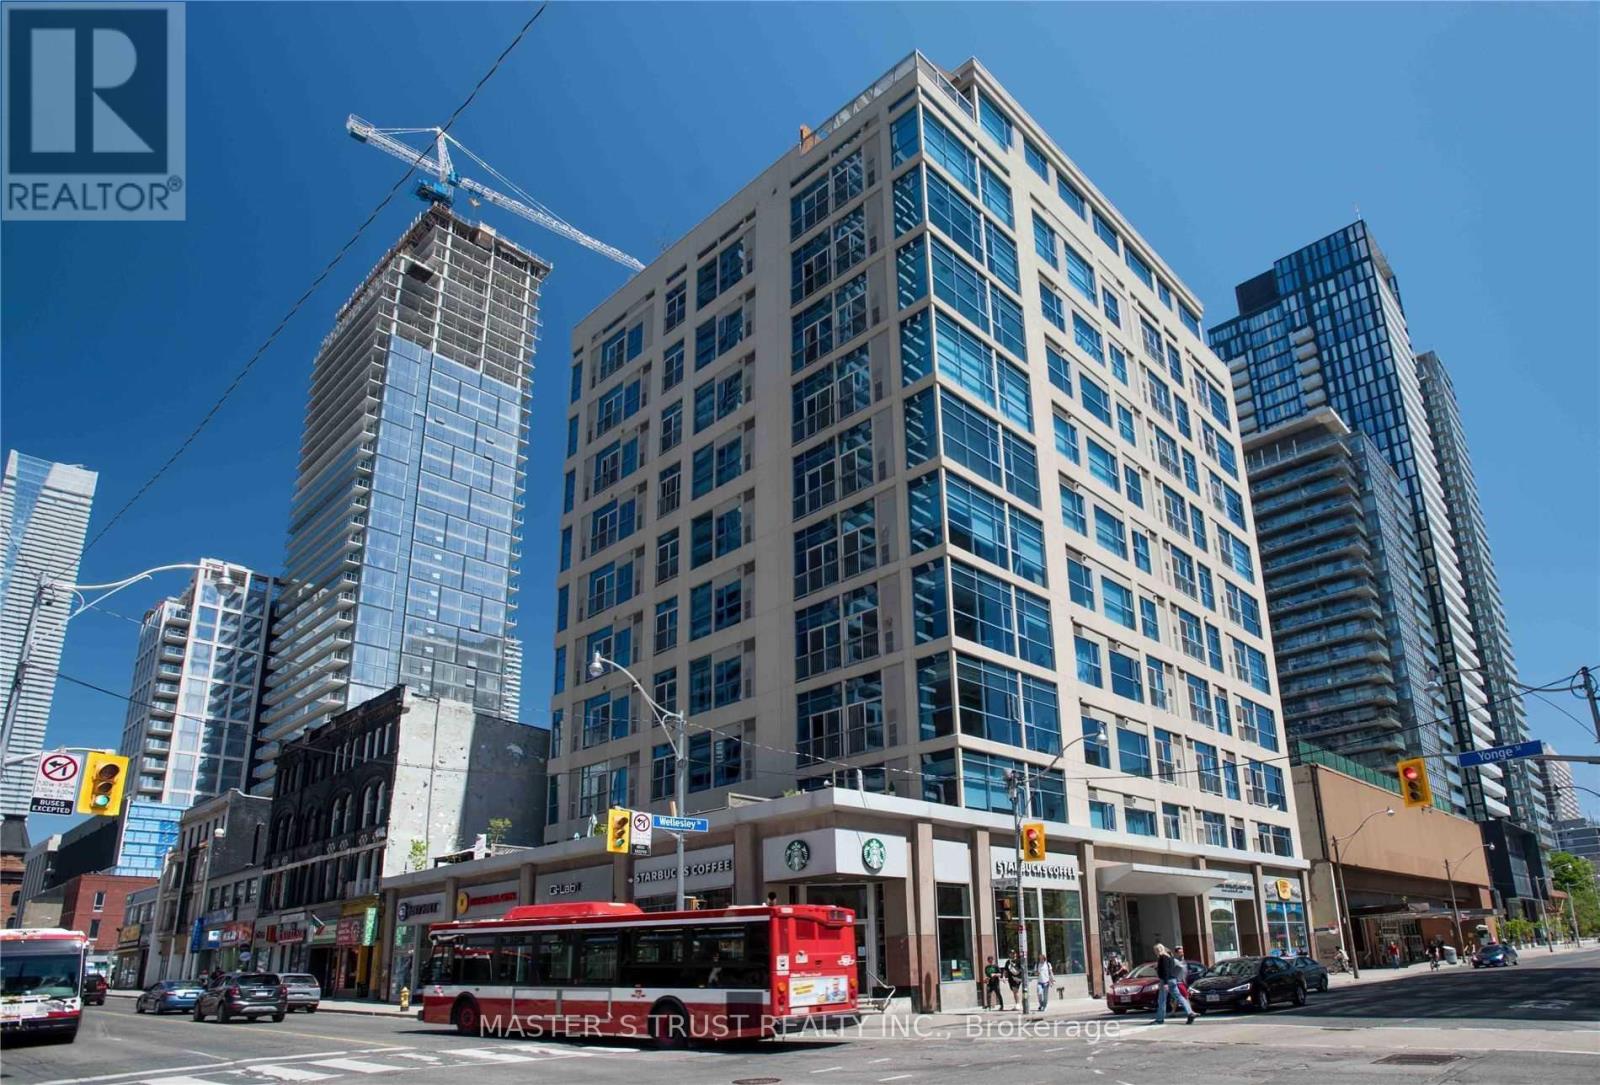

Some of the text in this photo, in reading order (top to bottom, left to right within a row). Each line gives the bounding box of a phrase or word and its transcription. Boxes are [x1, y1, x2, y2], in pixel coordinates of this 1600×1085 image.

[1478, 748, 1513, 760] Yonge
[31, 805, 70, 814] EXCEPTED
[659, 817, 696, 828] Wellesley
[634, 860, 732, 883] STARBUCS COFFEE
[1047, 866, 1076, 880] COFFEE
